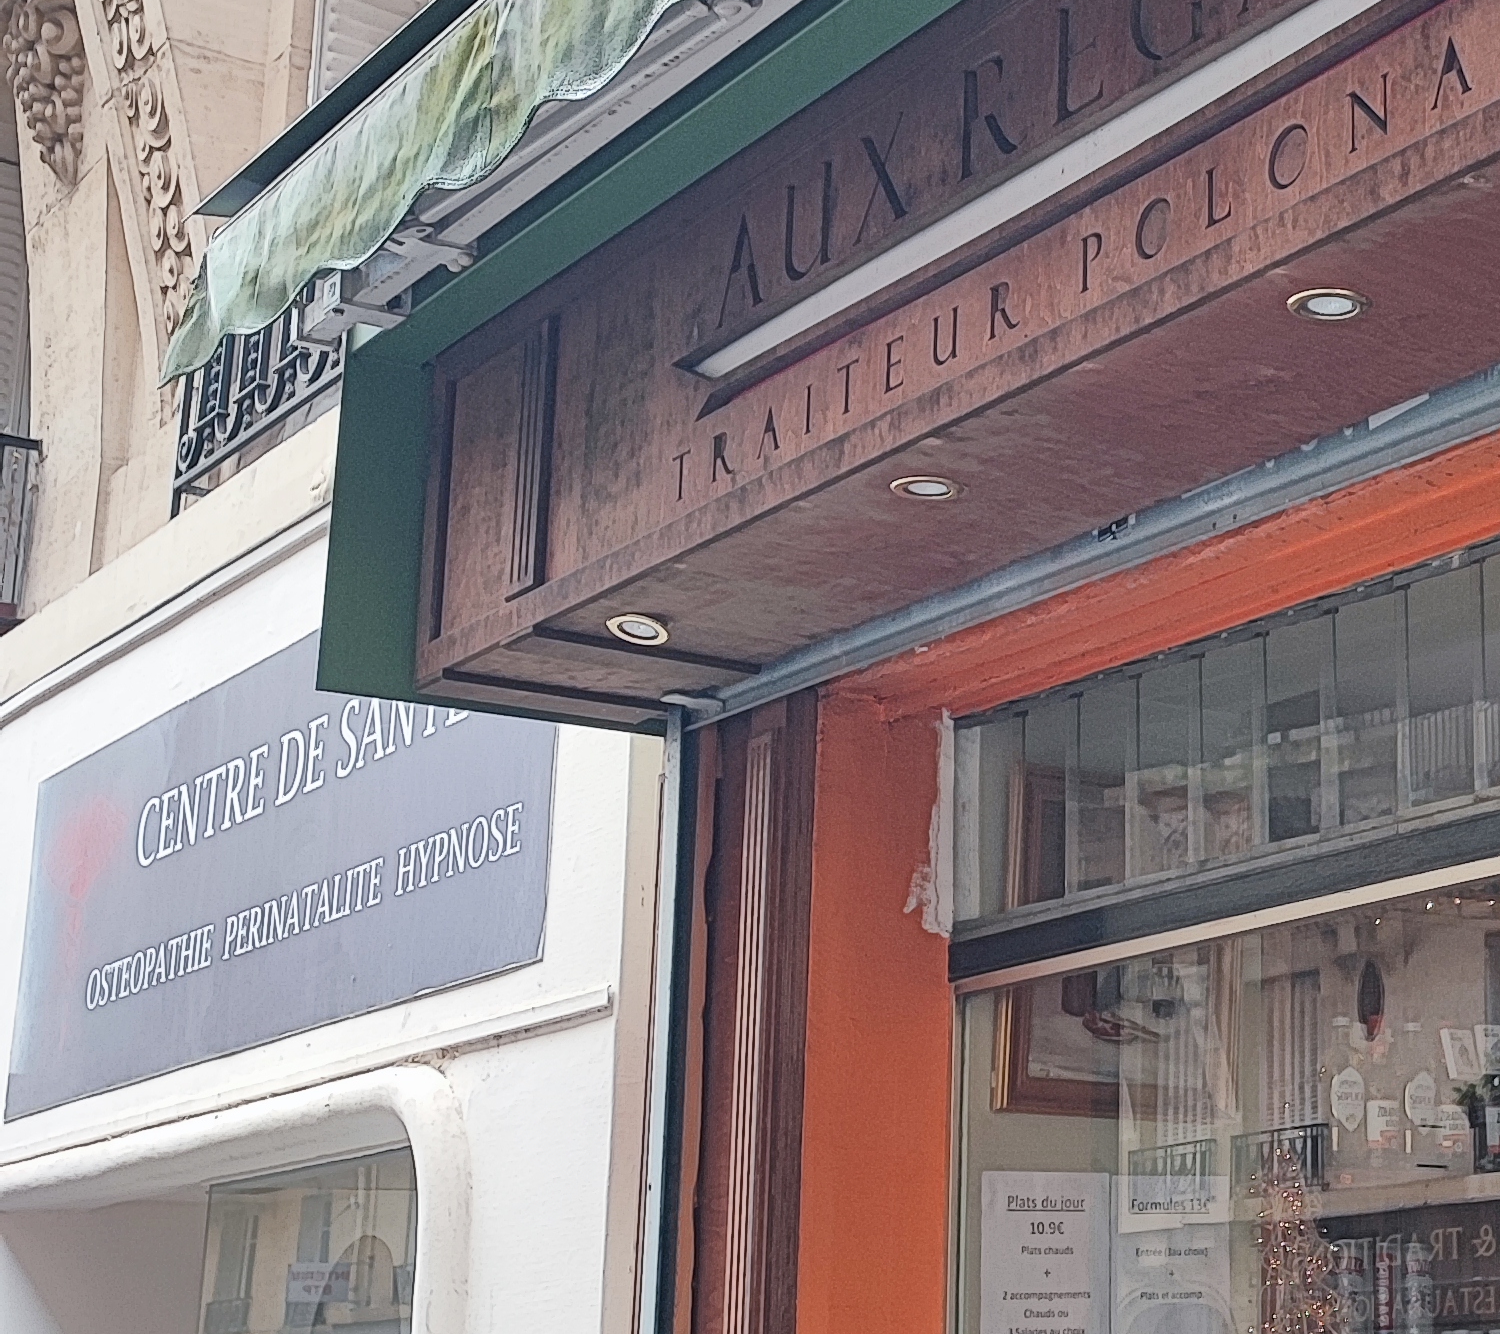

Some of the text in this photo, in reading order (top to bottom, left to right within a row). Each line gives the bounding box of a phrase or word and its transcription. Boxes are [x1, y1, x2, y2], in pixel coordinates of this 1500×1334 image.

[715, 112, 909, 329] AUX
[671, 279, 1020, 502] TRAITEUR
[135, 743, 269, 867] CENTRE
[276, 714, 329, 806] DE
[86, 803, 524, 1010] OSTEOPATHIE PERINATALITE HYPNOSE
[1007, 1195, 1085, 1211] Plats du jour
[1131, 1197, 1186, 1211] Formules
[1029, 1221, 1065, 1235] 10.9€
[1021, 1245, 1074, 1255] Plats chauds
[1002, 1291, 1091, 1302] 2 accompagnements
[1024, 1308, 1069, 1318] Chauds ou
